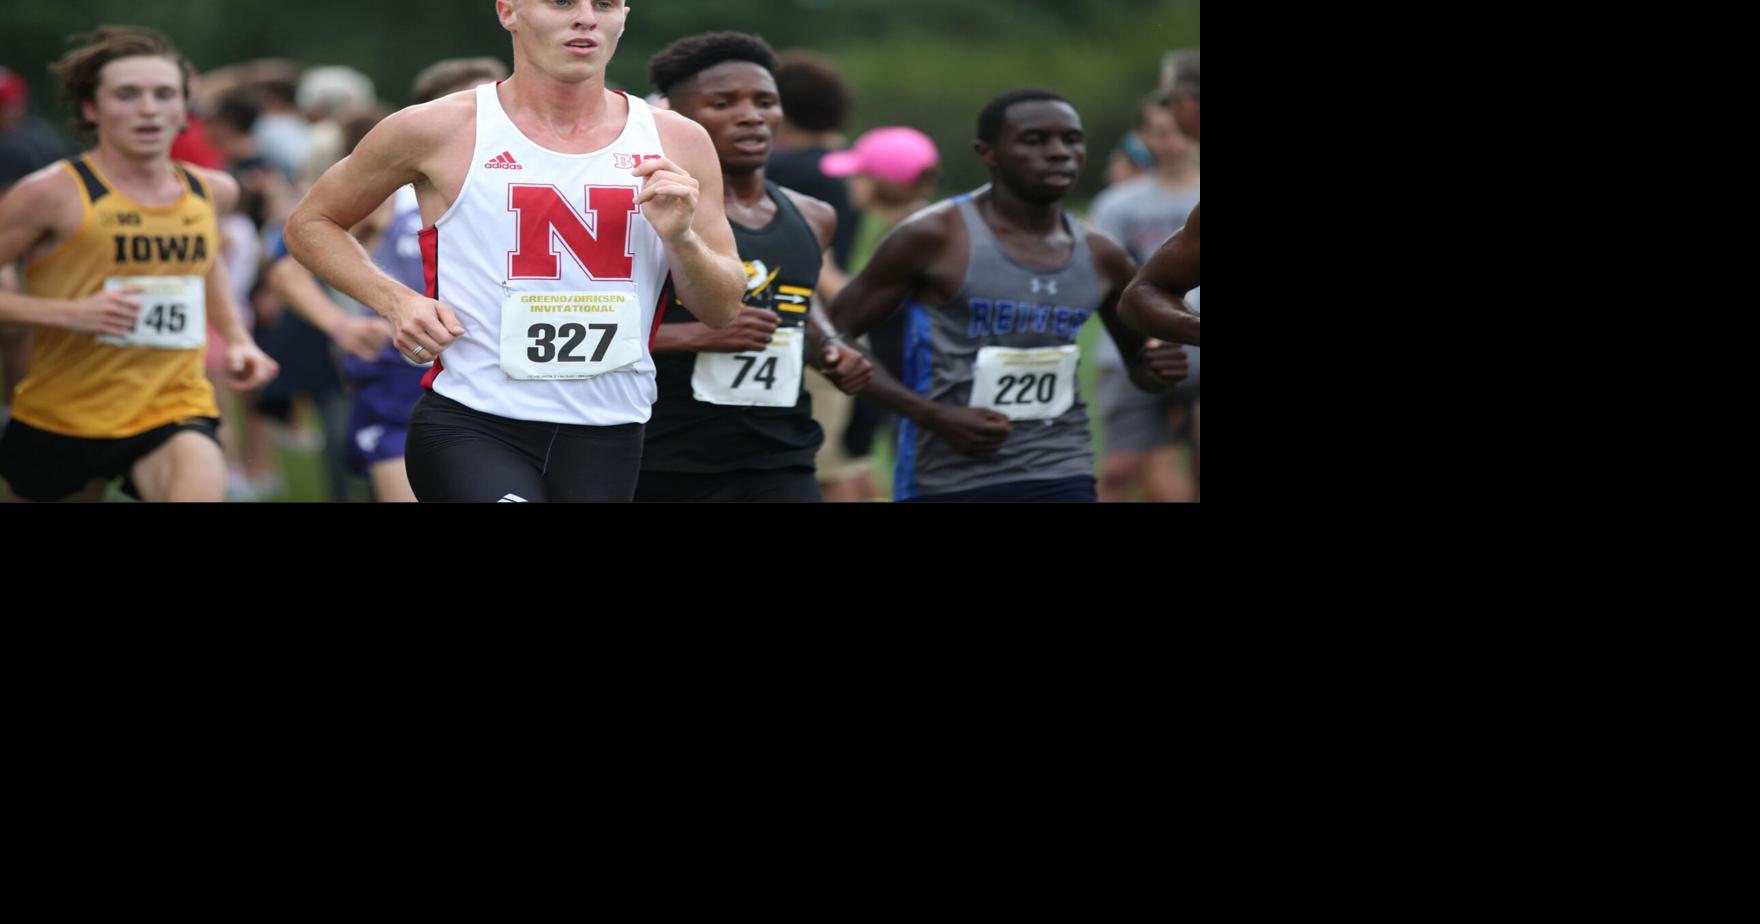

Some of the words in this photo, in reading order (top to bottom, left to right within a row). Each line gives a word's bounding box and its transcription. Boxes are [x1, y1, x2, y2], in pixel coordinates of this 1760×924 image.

[484, 161, 523, 170] adidas
[508, 183, 640, 281] N
[114, 234, 208, 263] IOWA
[520, 295, 625, 303] GREENO/DIRKSEN
[529, 304, 615, 313] INVITATIONAL
[129, 304, 186, 334] 45
[527, 322, 618, 363] 327
[730, 355, 778, 390] 74
[993, 372, 1056, 405] 220
